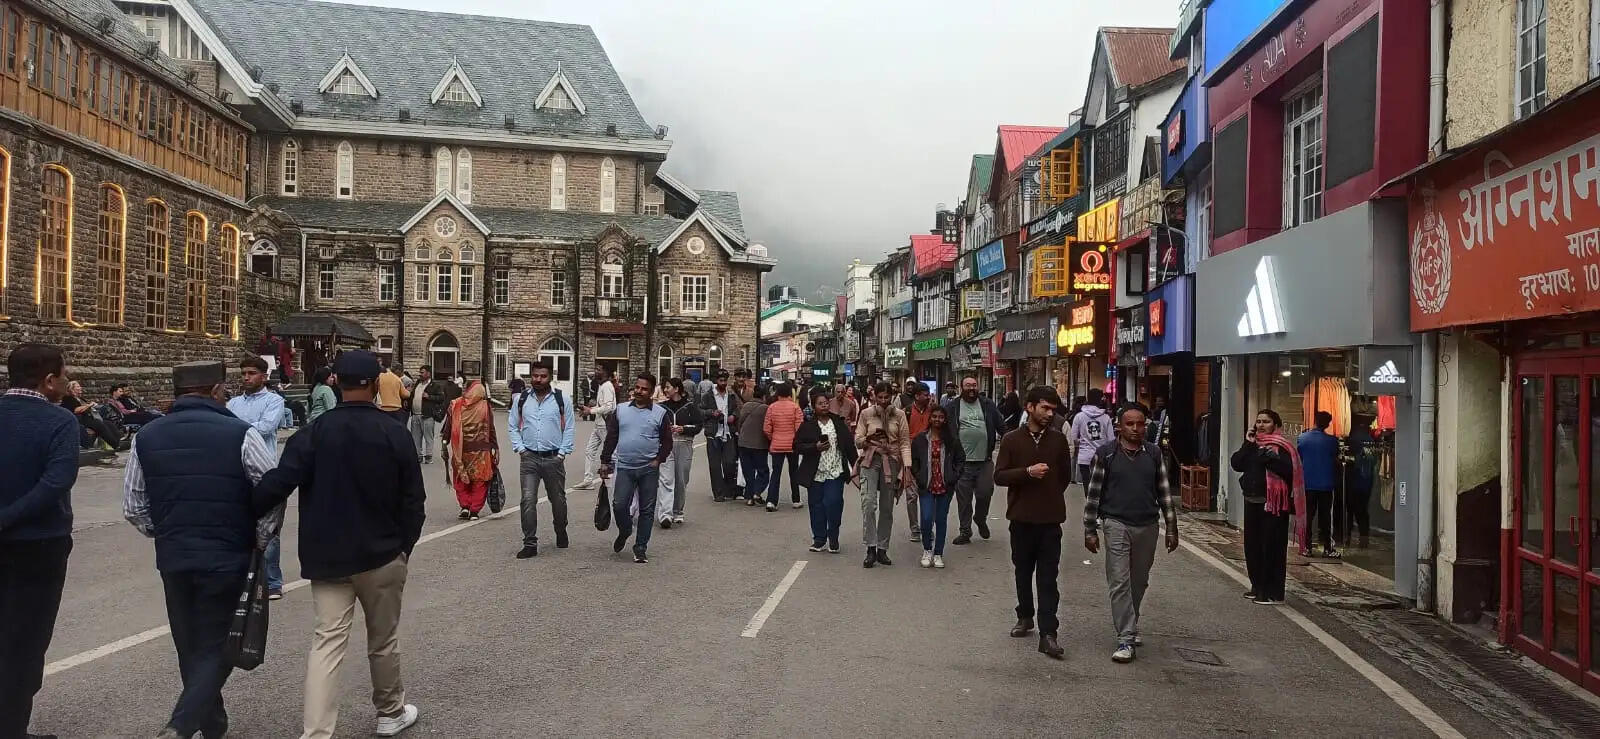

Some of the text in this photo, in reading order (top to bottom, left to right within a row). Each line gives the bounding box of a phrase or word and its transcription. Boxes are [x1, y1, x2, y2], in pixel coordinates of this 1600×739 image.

[1074, 272, 1110, 284] xero
[1074, 283, 1112, 292] degrees
[1072, 305, 1093, 326] xero
[1058, 325, 1093, 354] degrees
[1369, 374, 1406, 384] adidas
